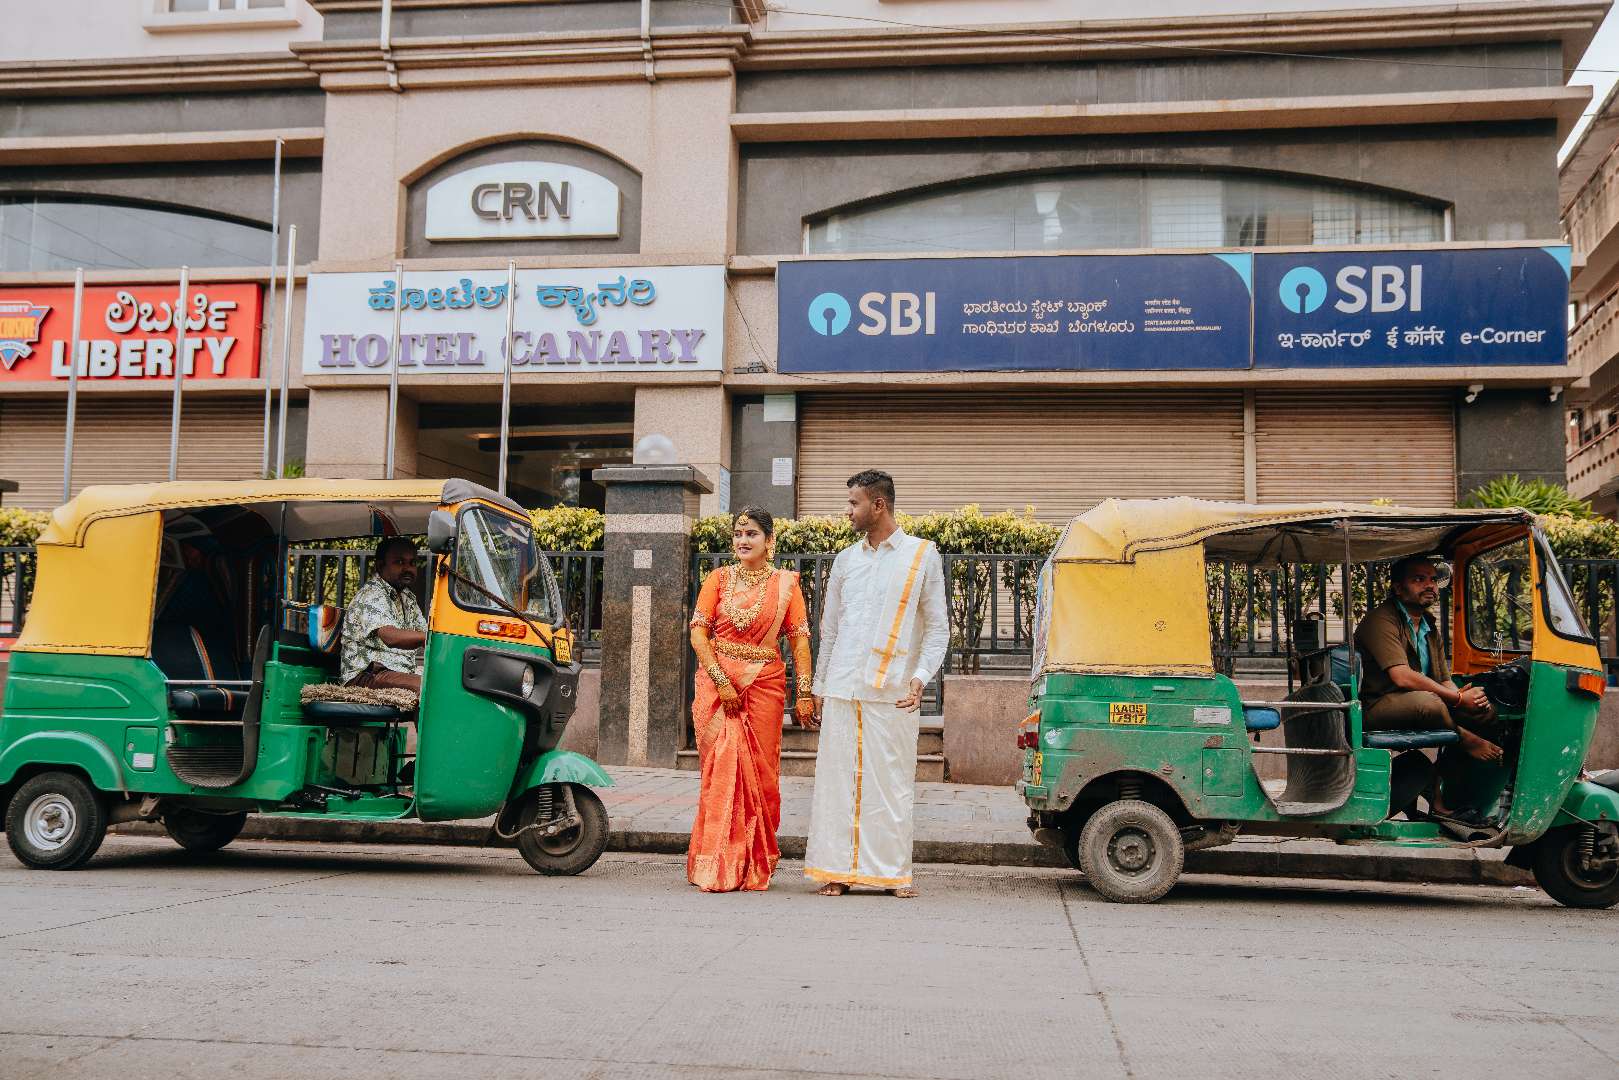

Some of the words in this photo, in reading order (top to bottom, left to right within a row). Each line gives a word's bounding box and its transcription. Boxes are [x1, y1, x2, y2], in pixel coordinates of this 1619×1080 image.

[471, 181, 571, 220] CRN
[536, 275, 658, 326] ಕ್ಯಾನರಿ
[963, 300, 1027, 316] ಭಾರತೀಯ
[1334, 264, 1422, 314] SBI
[857, 291, 936, 336] SBI
[318, 332, 485, 368] HOTEL
[501, 329, 706, 366] CANARY
[1386, 326, 1398, 349] ई
[1404, 326, 1445, 347] कॉर्नर
[1460, 327, 1546, 345] e-Corner
[51, 336, 236, 377] LIBERTY
